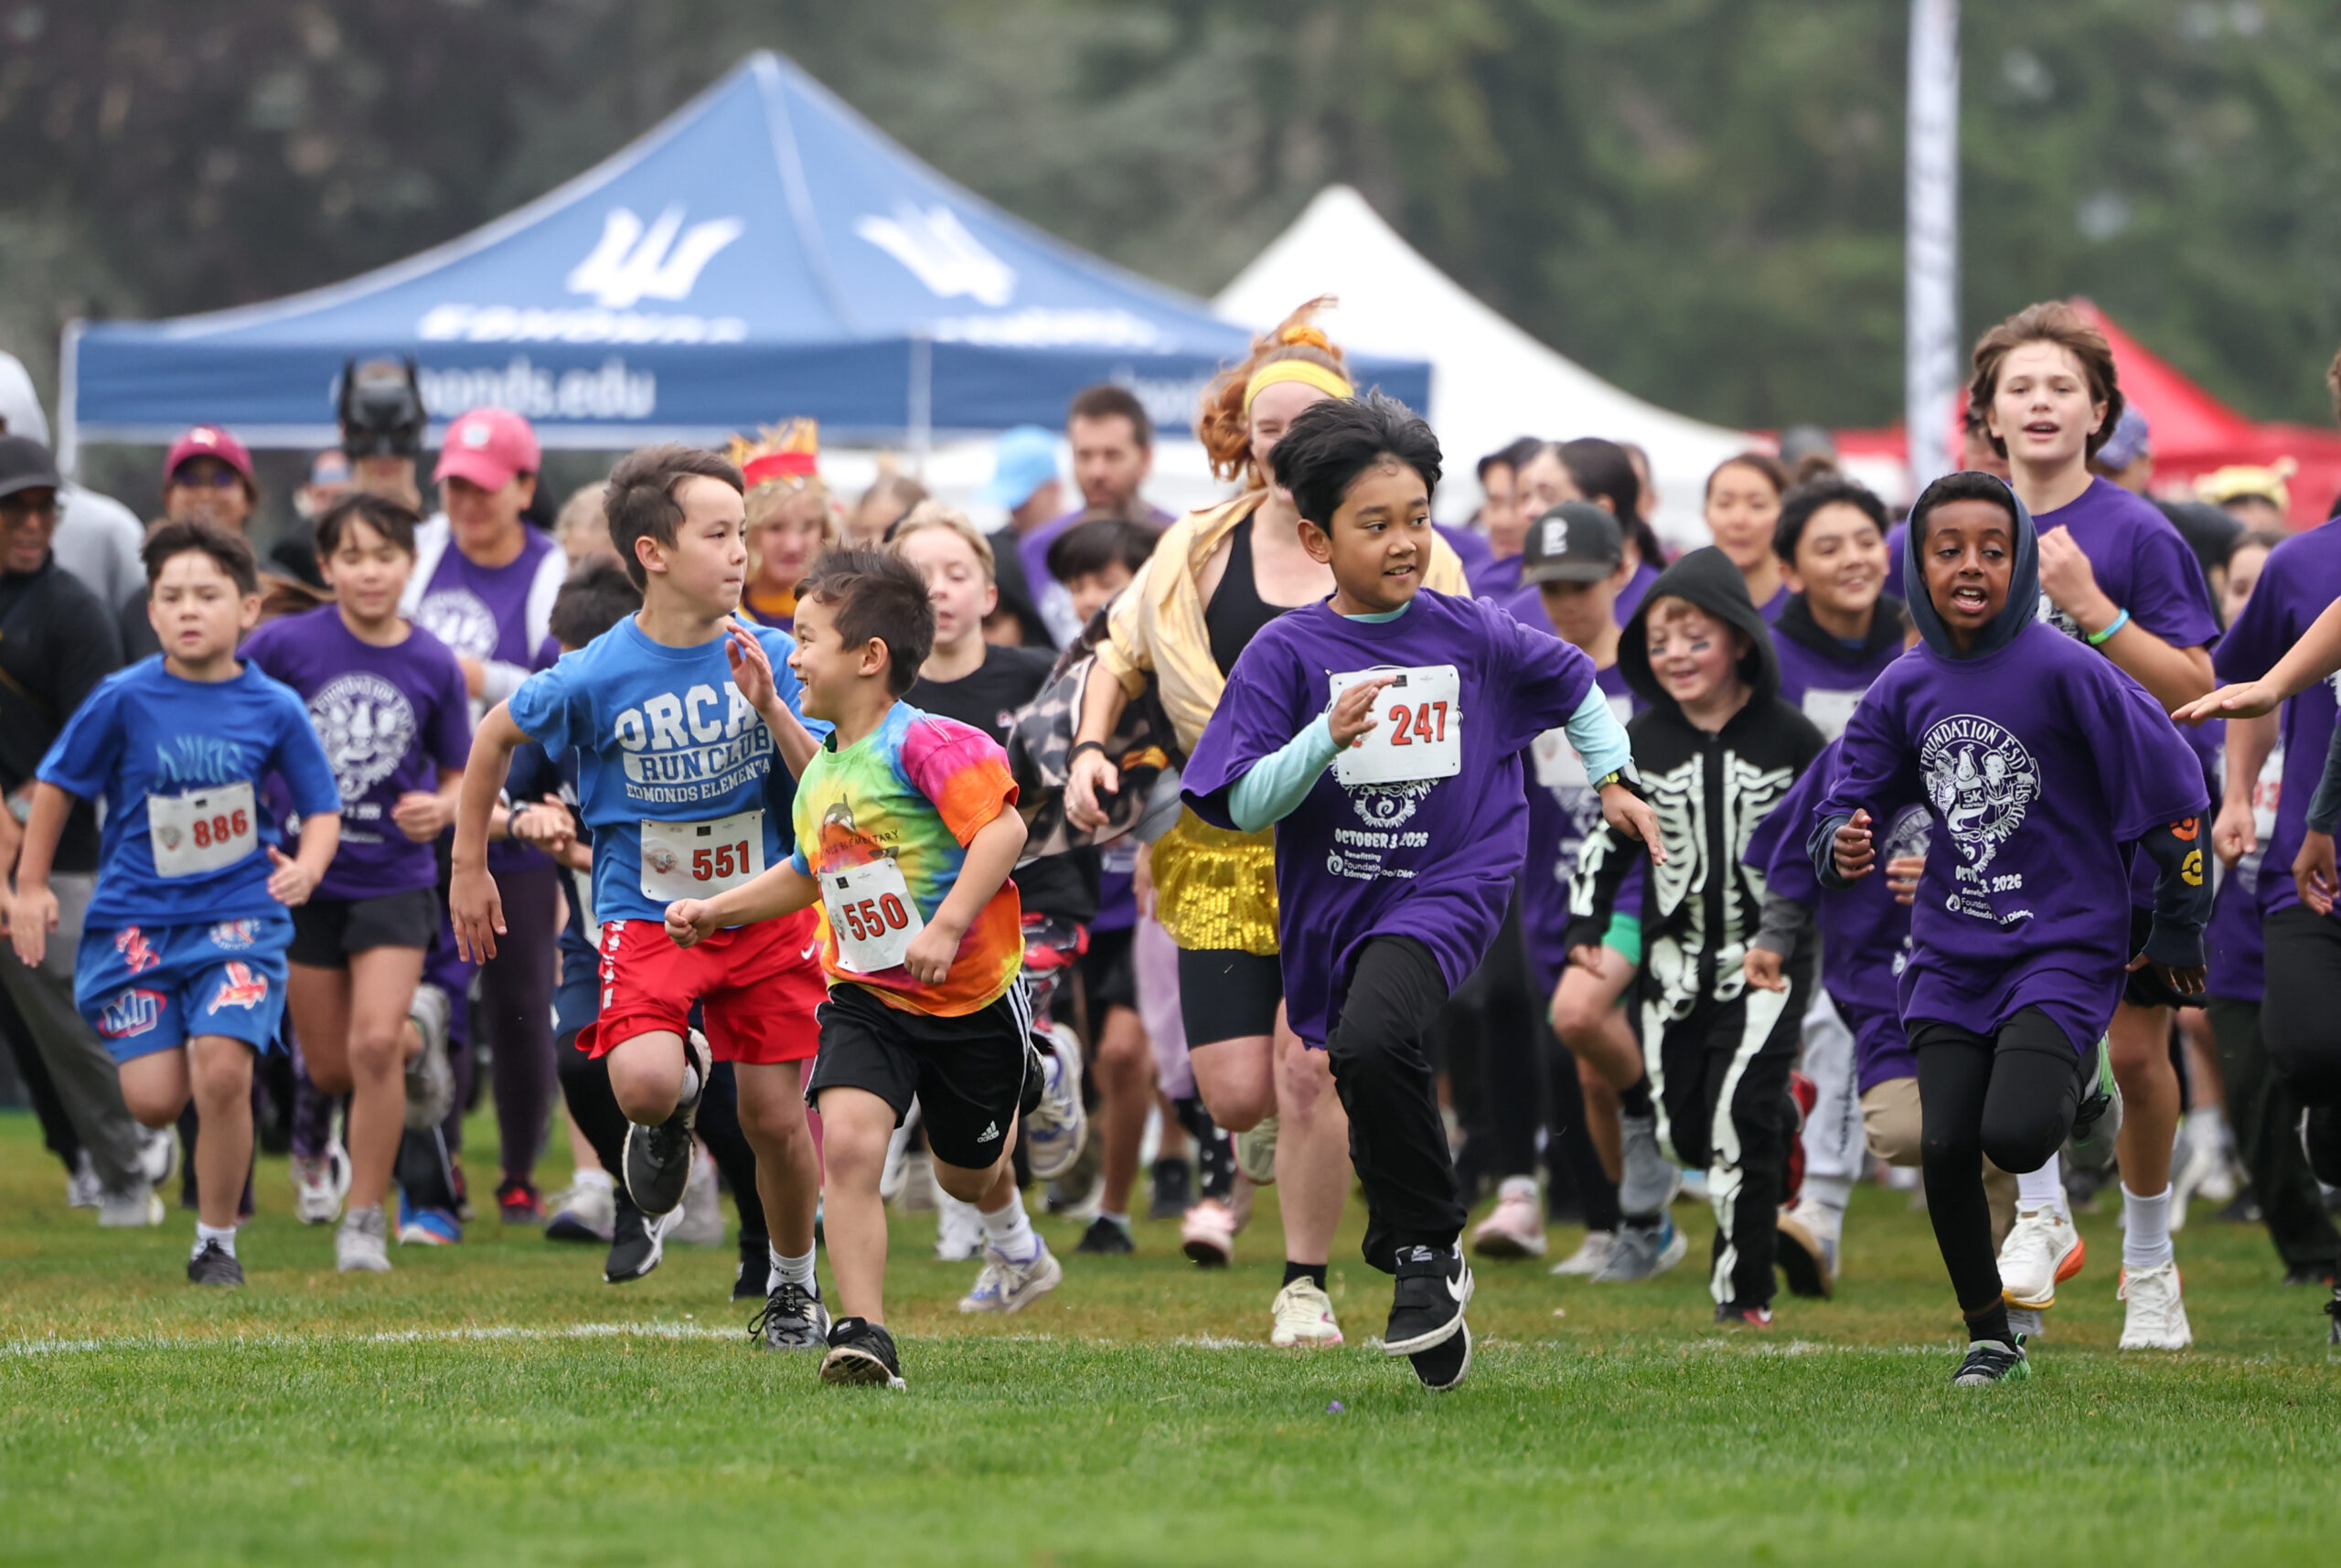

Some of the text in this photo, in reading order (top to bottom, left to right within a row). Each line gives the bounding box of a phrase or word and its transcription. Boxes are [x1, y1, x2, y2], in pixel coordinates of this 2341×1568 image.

[615, 681, 758, 752] ORCA
[1389, 701, 1448, 746] 247
[640, 725, 770, 782] RUN CLUB
[1920, 719, 2026, 770] FOUNDATION ESD
[625, 782, 699, 804] EDMONDS
[1962, 790, 1983, 804] 5K
[193, 808, 248, 849] 886
[1335, 828, 1389, 848] OCTOBER
[1398, 832, 1429, 848] 2026
[692, 839, 750, 881] 551
[1344, 849, 1382, 863] Benefitting
[1992, 873, 2023, 892] 2026
[841, 892, 909, 942] 550
[1962, 906, 1994, 920] Edmonds
[977, 1129, 999, 1144] adidas
